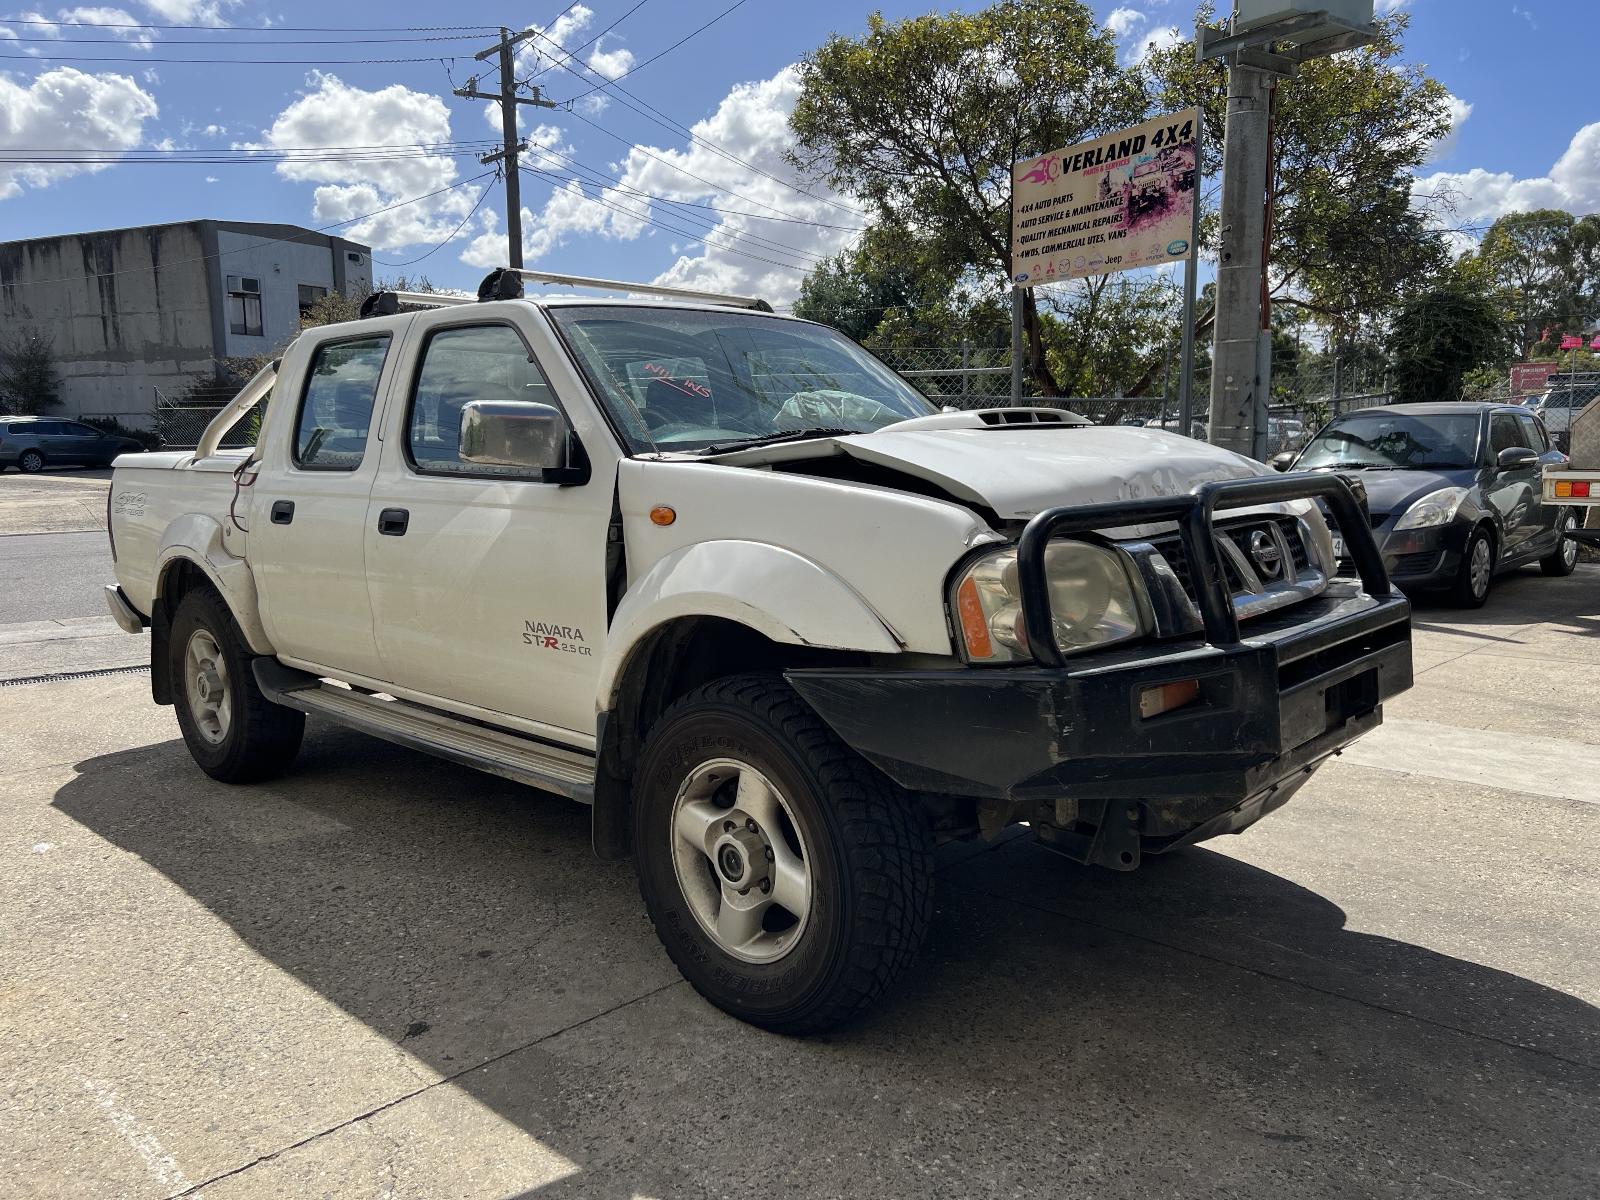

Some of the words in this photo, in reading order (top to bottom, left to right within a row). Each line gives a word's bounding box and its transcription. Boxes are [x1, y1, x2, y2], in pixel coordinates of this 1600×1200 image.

[1151, 120, 1192, 148] 4X4
[1020, 204, 1033, 214] 4X4
[1034, 199, 1052, 210] AUTO
[1053, 193, 1073, 206] PARTS
[1020, 218, 1037, 229] AUTO
[1038, 212, 1064, 224] SERVICE
[1065, 210, 1071, 218] &
[1071, 196, 1124, 216] MAINTENANCE
[1020, 231, 1046, 245] QUALITY
[1047, 221, 1091, 238] MECHANICAL
[1092, 213, 1123, 228] REPAIRS
[1041, 238, 1086, 254] COMMERCIAL
[1087, 234, 1106, 245] UTES,
[1108, 229, 1127, 241] VANS
[1105, 255, 1122, 264] Jeep
[525, 620, 584, 641] NAVARA
[522, 632, 560, 650] ST-R
[561, 643, 576, 653] 2.5
[578, 646, 592, 656] CR
